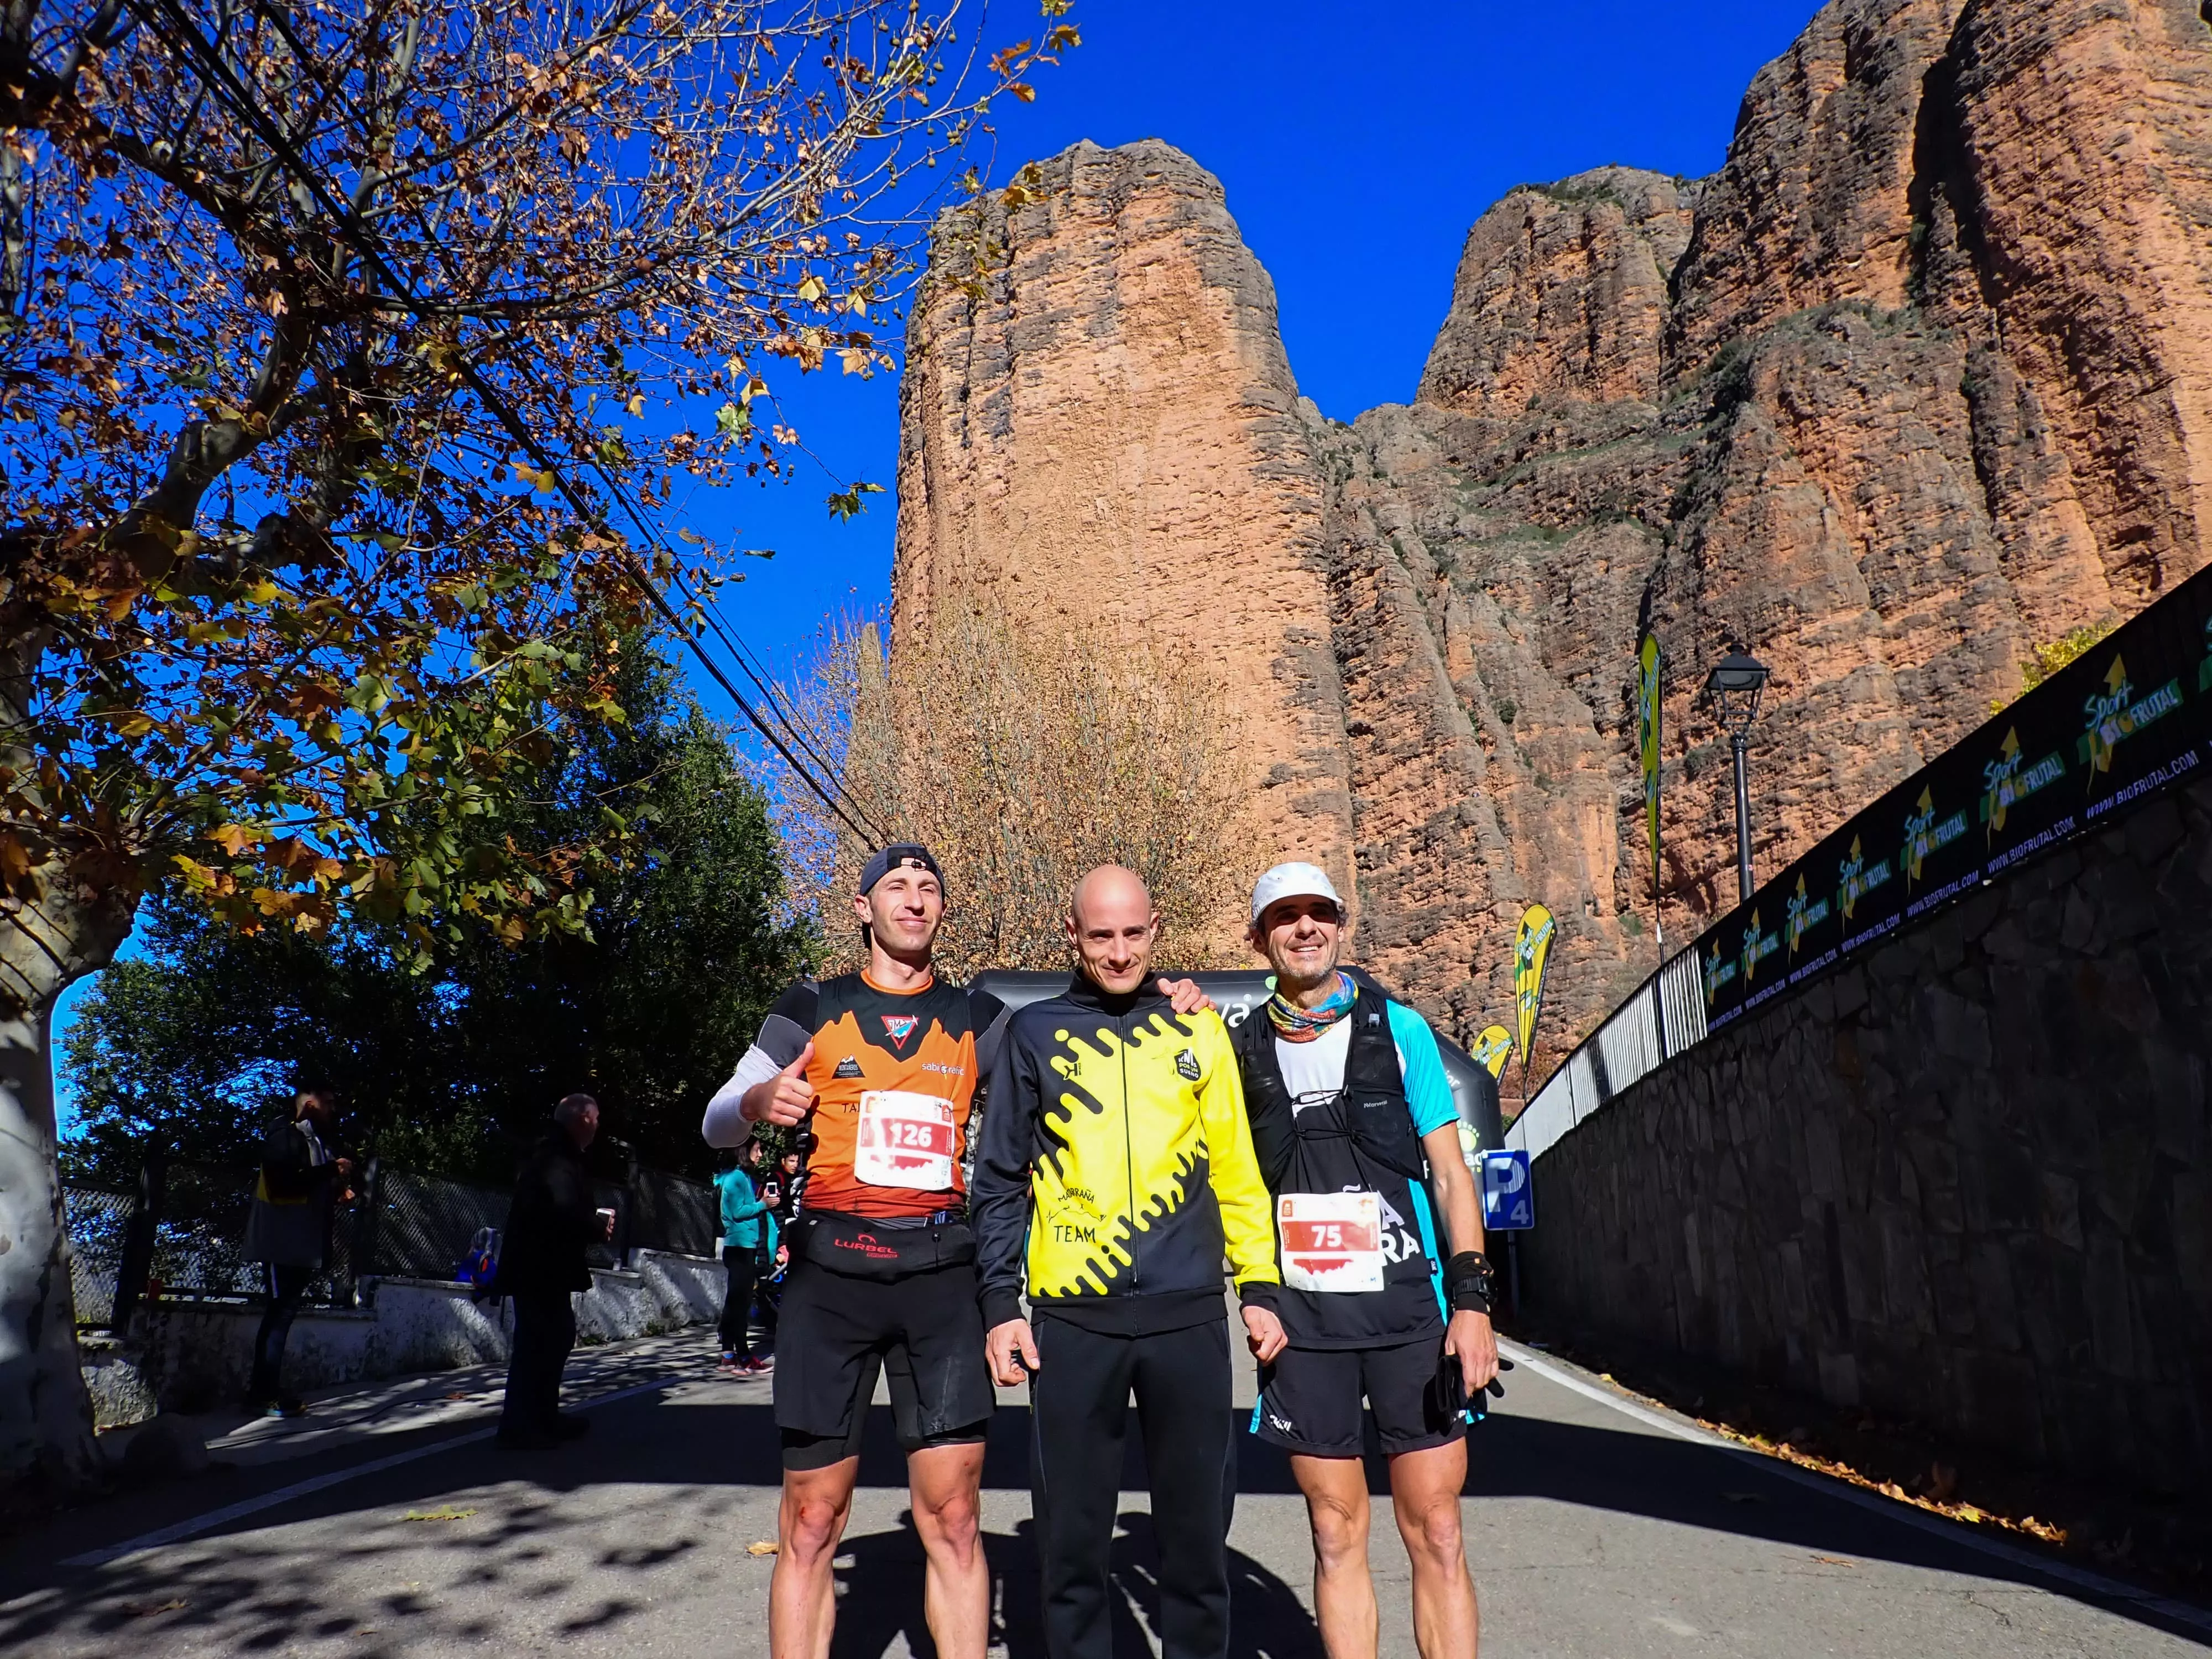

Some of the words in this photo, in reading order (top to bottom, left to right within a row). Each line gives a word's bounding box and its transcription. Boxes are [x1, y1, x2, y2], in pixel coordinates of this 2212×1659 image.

[2084, 679, 2133, 732] Sport
[1984, 748, 2023, 795] Sport
[1904, 807, 1935, 847] Sport
[1987, 816, 2076, 874] WWW.BIOFRUTAL.COM
[889, 1123, 932, 1147] 126
[1484, 1157, 1525, 1213] P
[1510, 1200, 1530, 1224] 4
[834, 1239, 898, 1254] LURBEL
[1053, 1225, 1096, 1244] TEAM
[1311, 1225, 1342, 1248] 75
